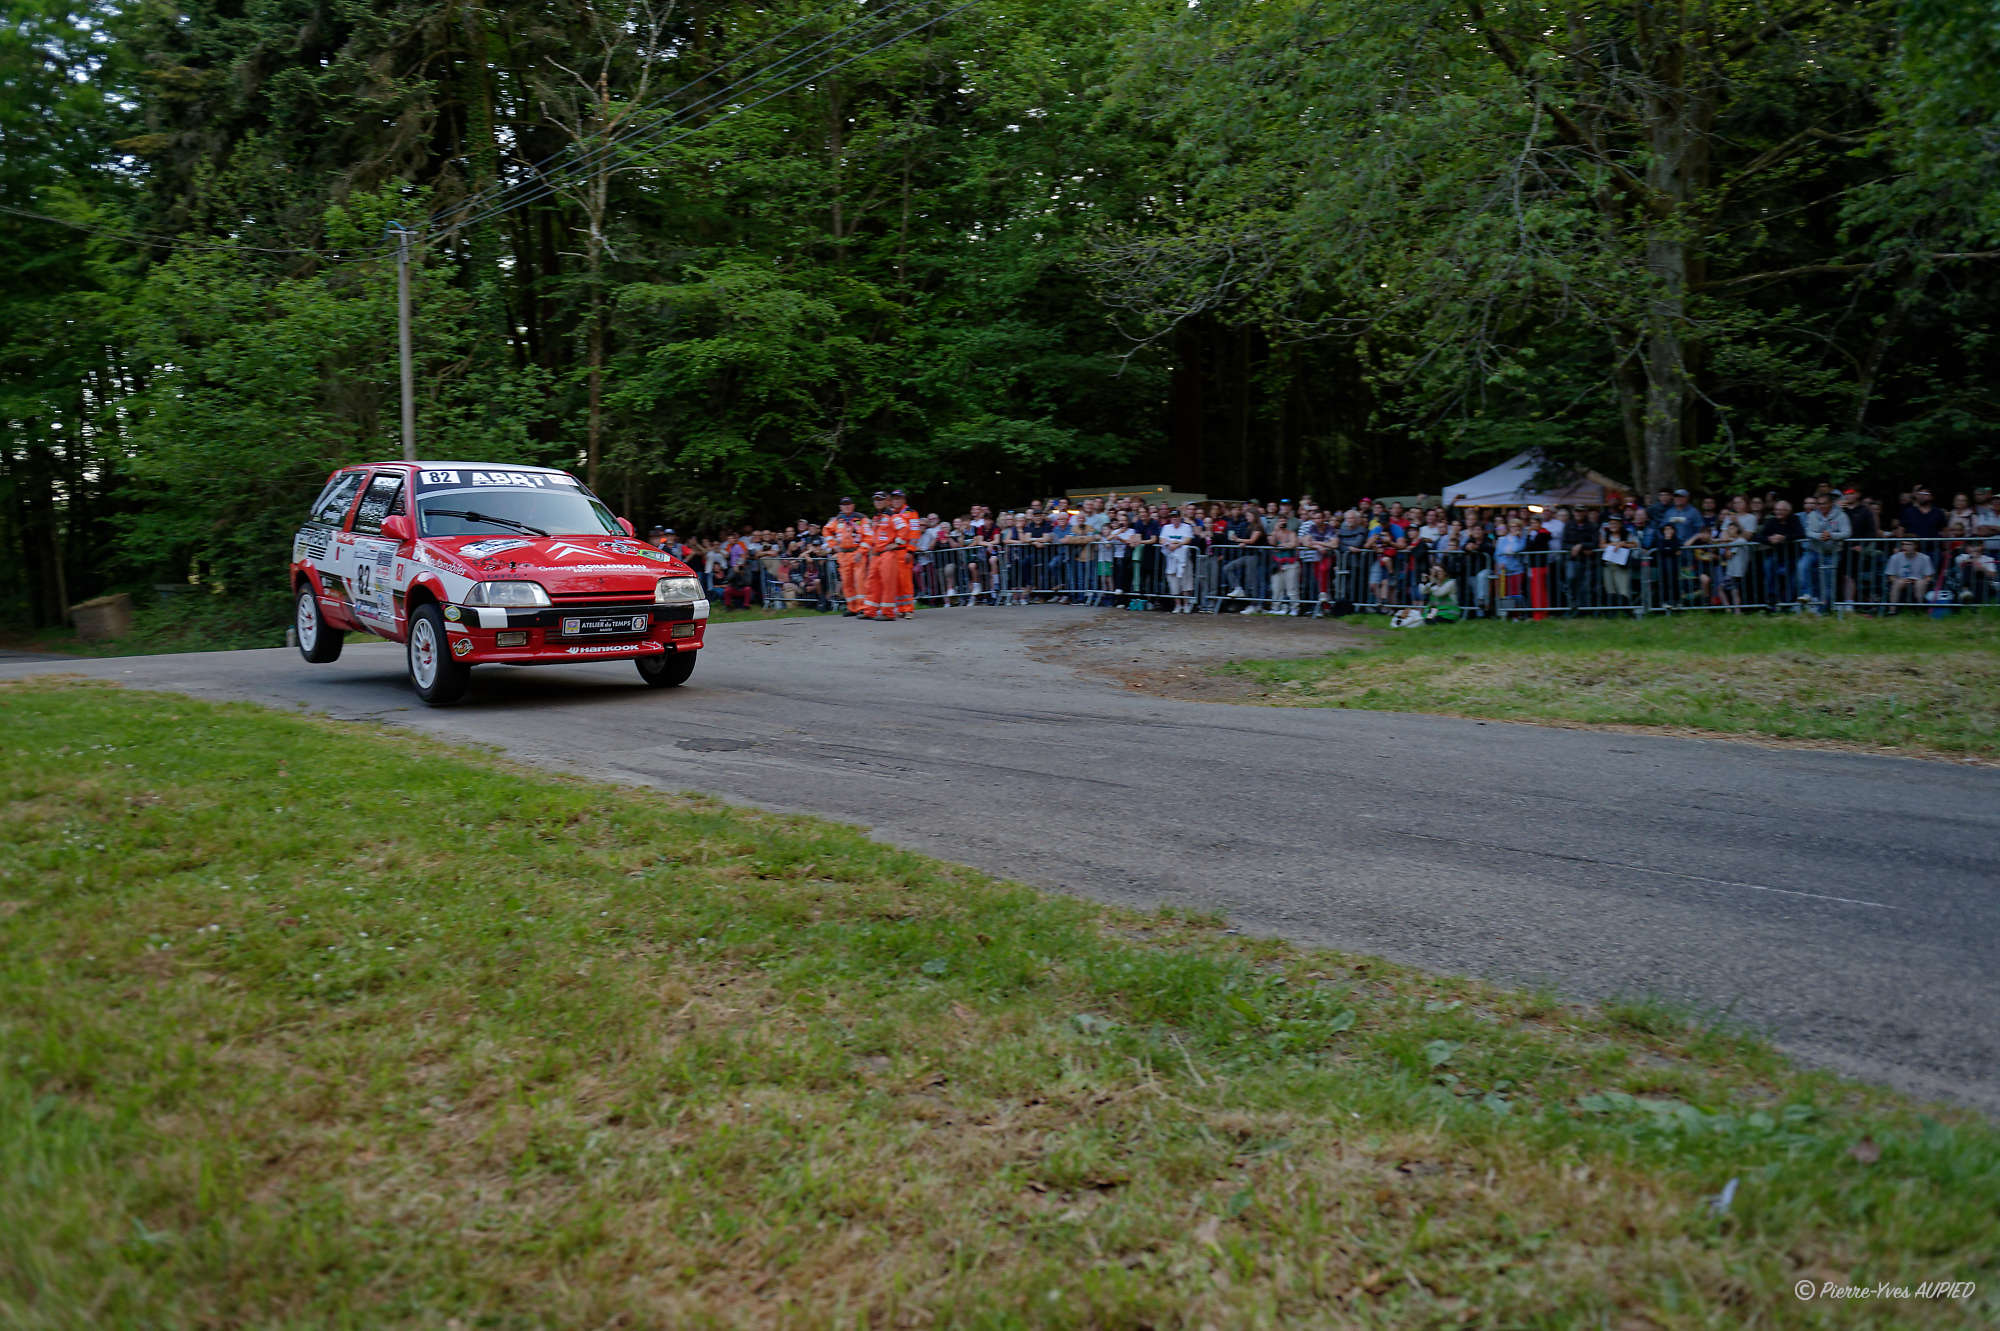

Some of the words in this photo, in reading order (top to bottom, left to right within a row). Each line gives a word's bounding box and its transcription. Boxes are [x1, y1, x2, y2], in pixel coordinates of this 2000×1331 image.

[429, 471, 451, 483] 82
[358, 564, 371, 596] 82
[581, 621, 605, 629] ATELIER
[612, 620, 631, 628] TEMPS
